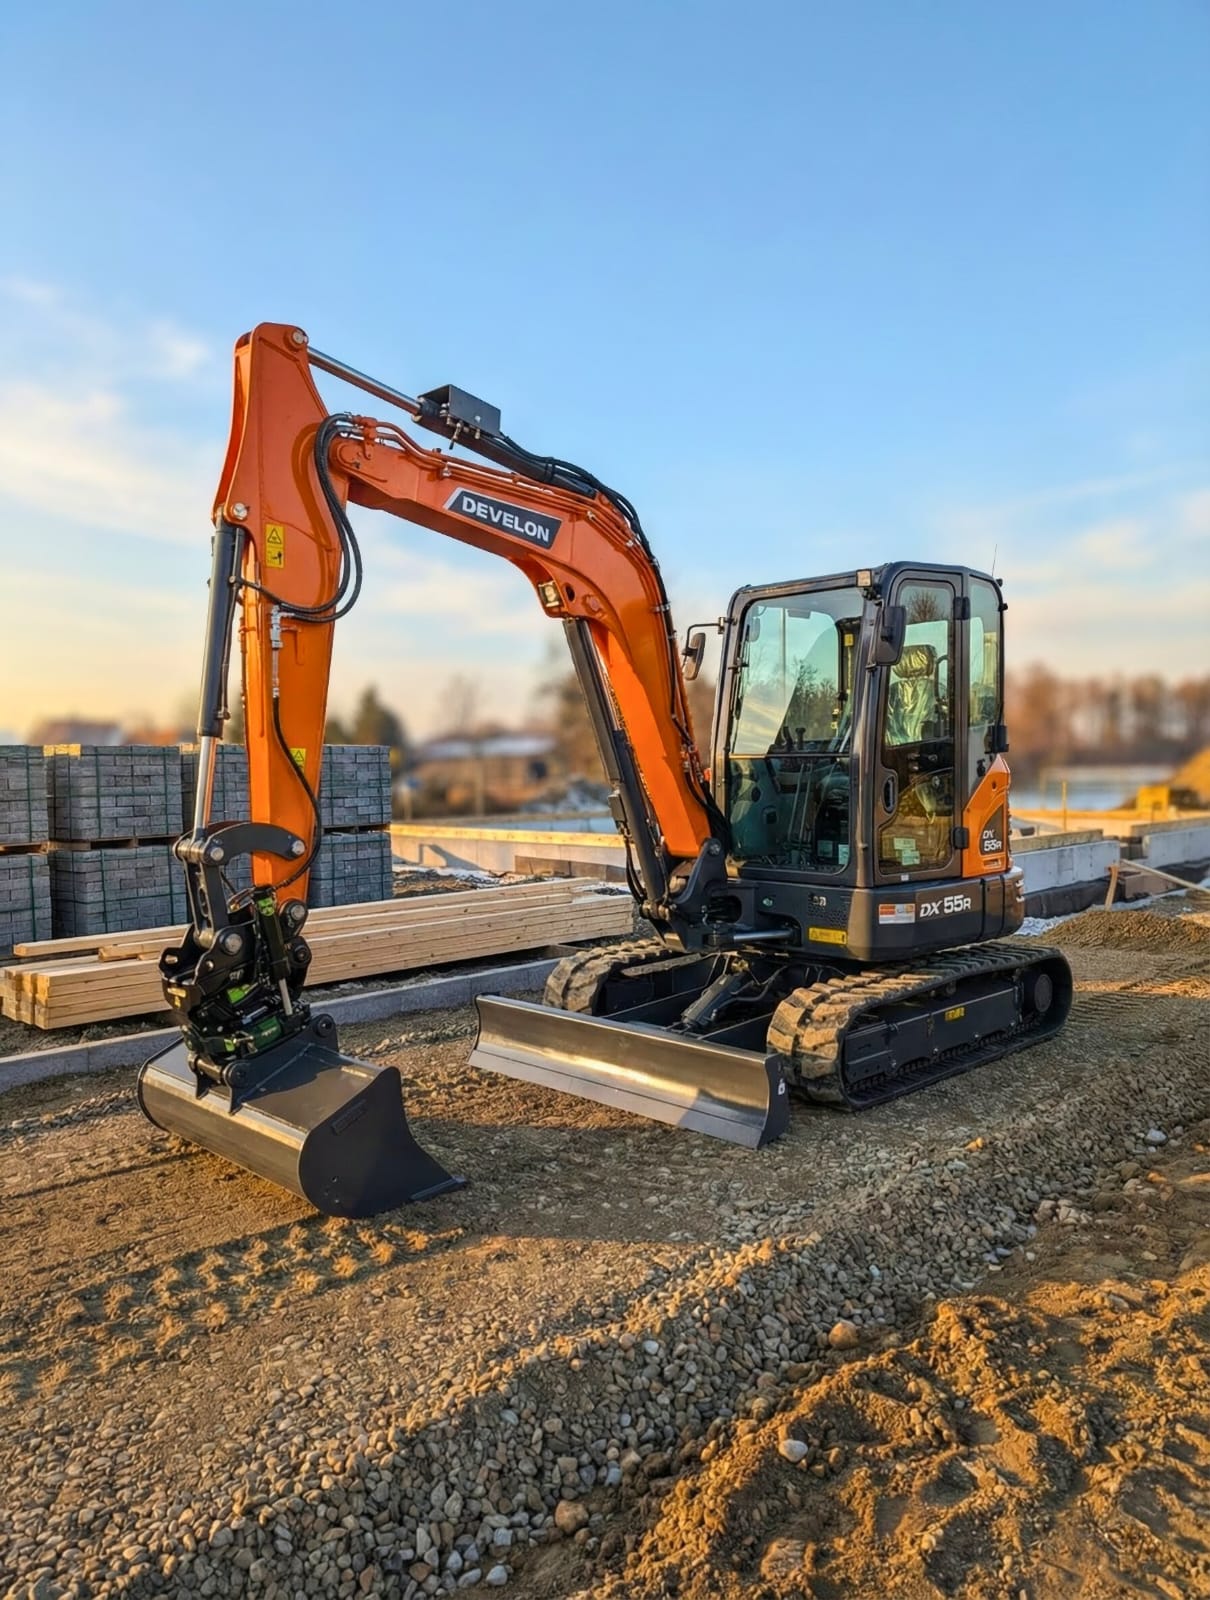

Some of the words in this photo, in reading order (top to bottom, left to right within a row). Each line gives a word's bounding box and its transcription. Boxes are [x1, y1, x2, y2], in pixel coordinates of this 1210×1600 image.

[462, 495, 550, 542] DEVELON
[920, 900, 943, 918] DX
[943, 894, 971, 914] 55R
